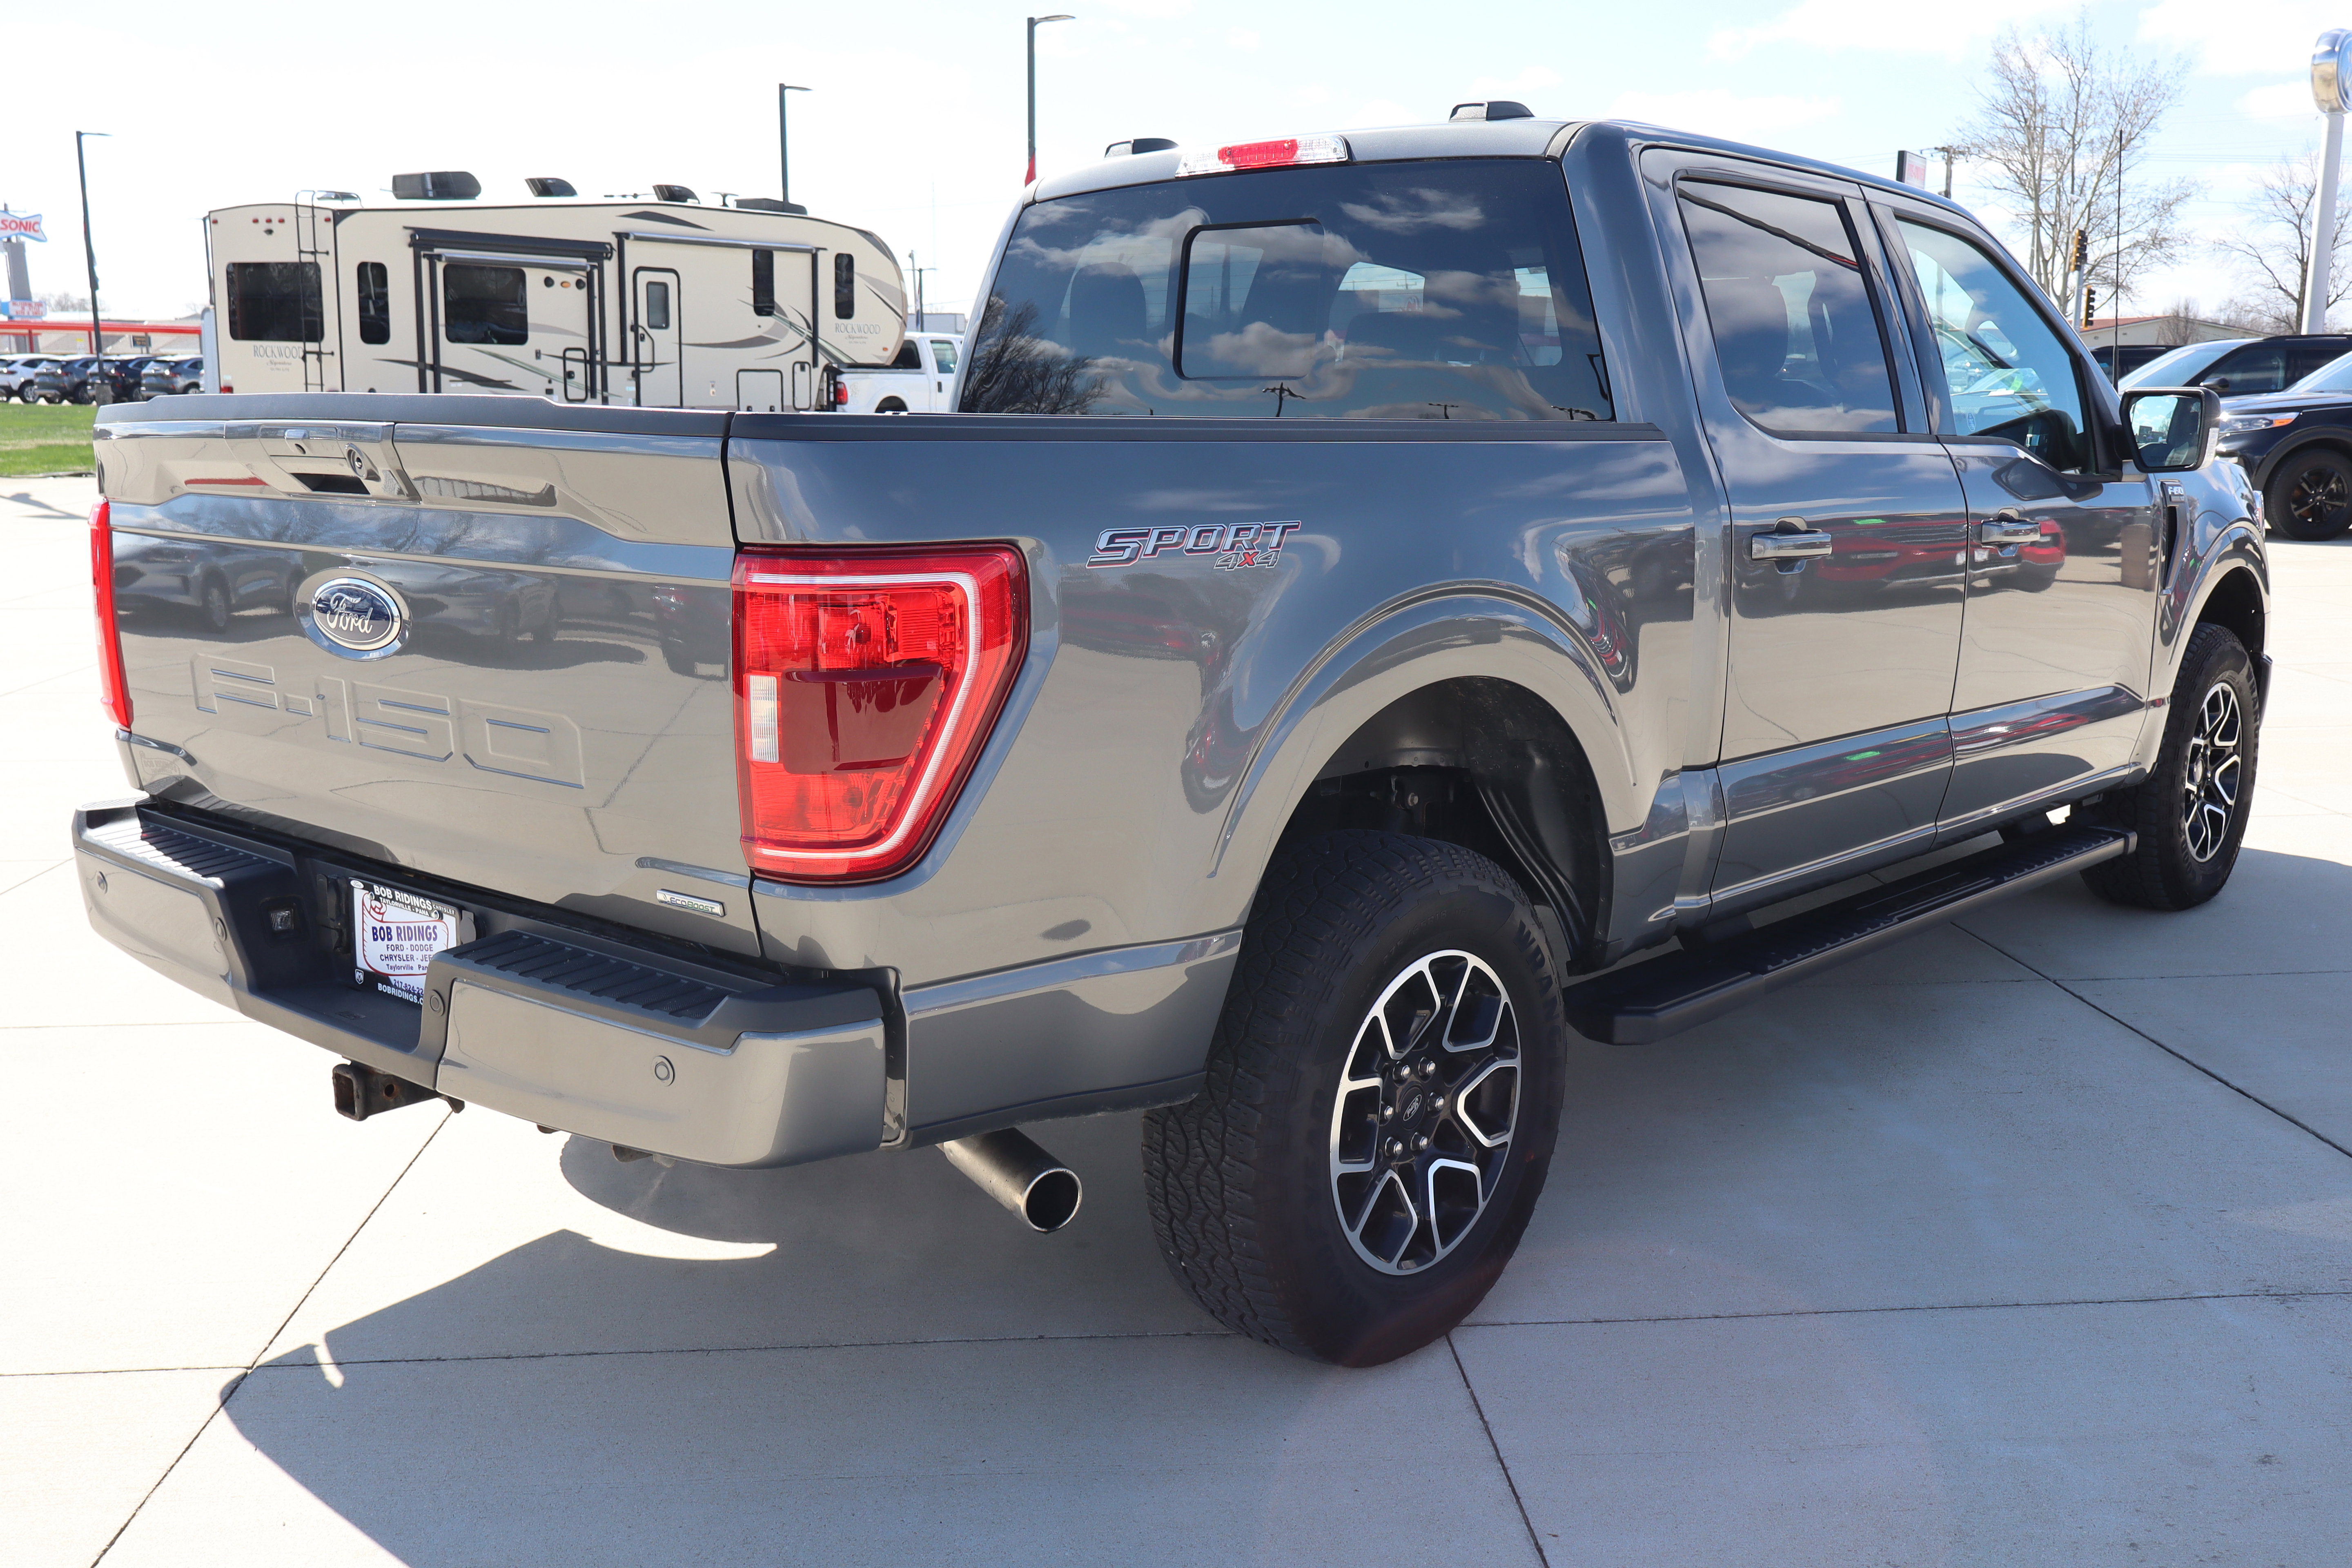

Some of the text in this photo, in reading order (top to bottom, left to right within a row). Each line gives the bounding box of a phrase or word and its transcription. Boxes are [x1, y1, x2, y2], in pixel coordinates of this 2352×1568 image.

[0, 218, 40, 233] SONIC
[835, 323, 881, 334] ROCKWOOD
[253, 345, 304, 359] ROCKWOOD
[1086, 520, 1302, 569] SPORT
[327, 592, 374, 634] Ford
[191, 653, 585, 790] F-150
[373, 885, 432, 911] BOB RIDINGS
[379, 897, 412, 911] TAYLORVILLE
[416, 908, 429, 916] PANA
[433, 904, 455, 915] CHRYSLER
[372, 925, 438, 942] BOB RIDINGS
[1406, 1097, 1419, 1118] Ford
